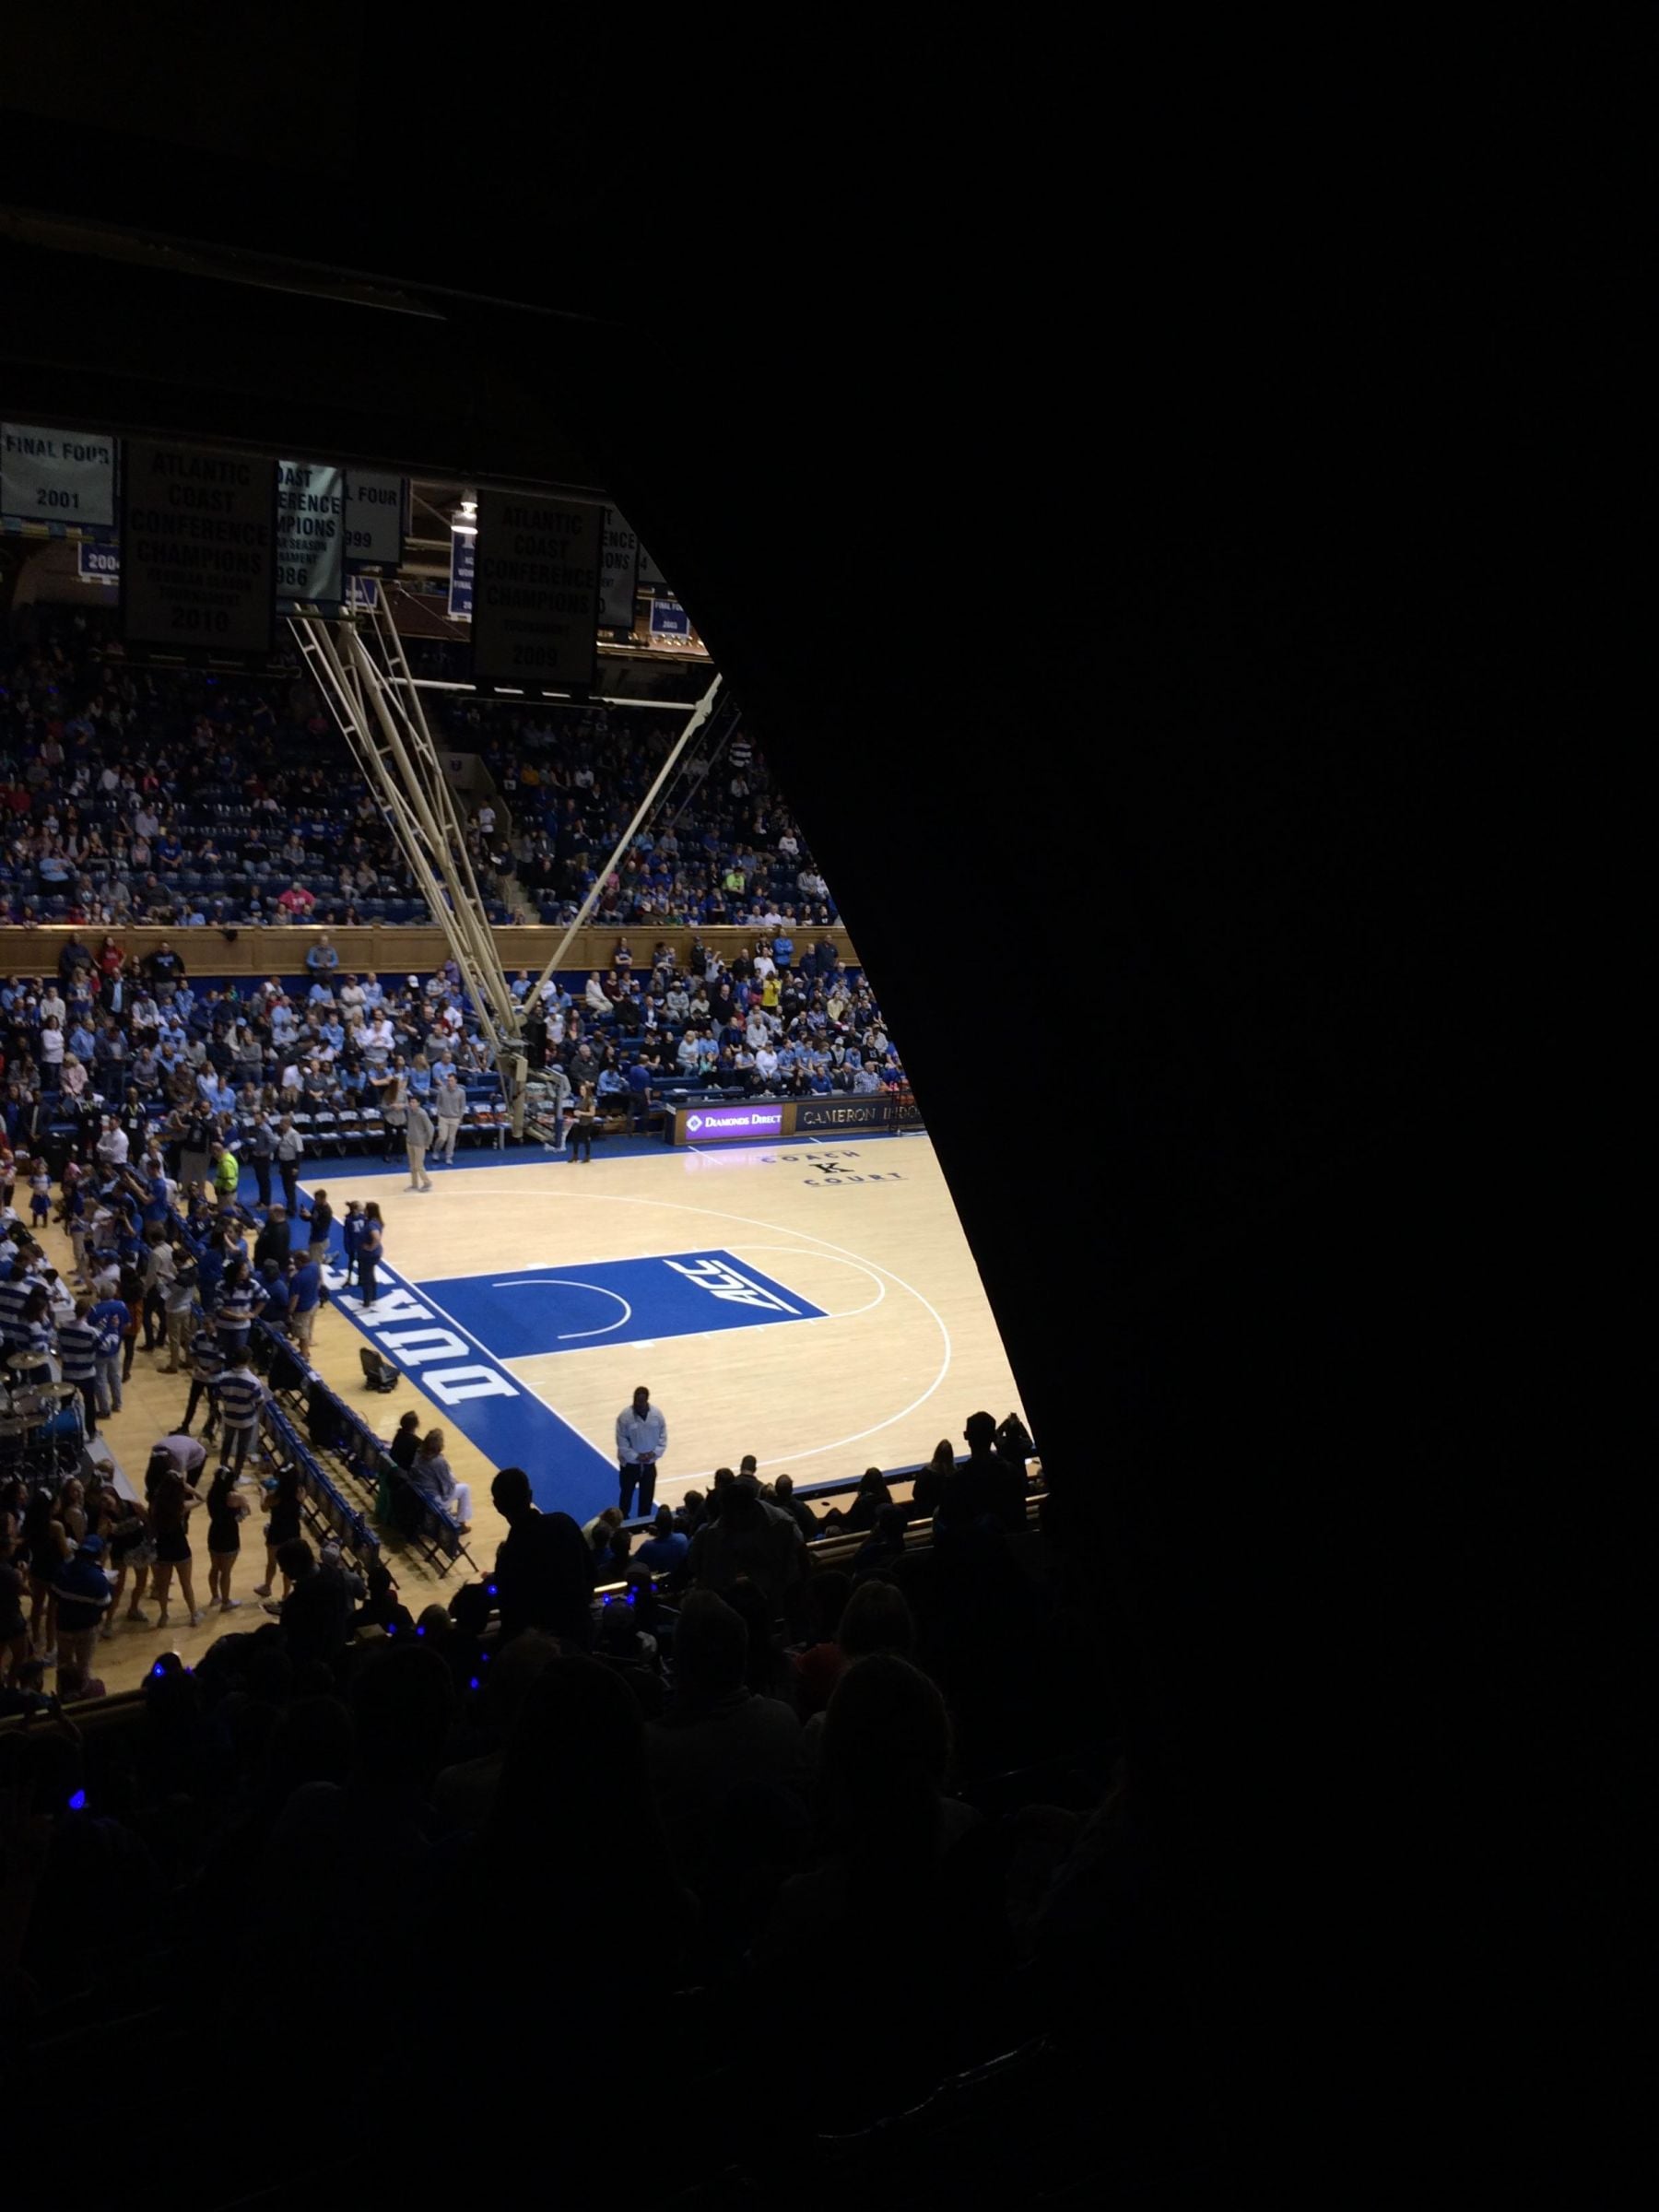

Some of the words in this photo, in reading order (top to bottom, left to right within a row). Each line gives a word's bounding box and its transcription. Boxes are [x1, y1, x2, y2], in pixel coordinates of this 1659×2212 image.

[6, 434, 57, 459] FINAL
[152, 452, 251, 486] ATLANTIC
[37, 488, 80, 509] 2001
[170, 484, 236, 513] COAST
[359, 487, 398, 506] FOUR
[131, 510, 269, 547] CONFERENCE
[501, 506, 582, 535] ATLANTIC
[137, 540, 262, 575] CHAMPIONS
[513, 533, 571, 559] COAST
[483, 557, 594, 589] CONFERENCE
[487, 583, 591, 615] CHAMPIONS
[171, 606, 229, 633] 2010
[514, 645, 559, 667] 2009
[803, 1107, 877, 1125] CAMERON
[760, 1150, 861, 1164] COACH
[808, 1161, 855, 1174] K
[803, 1171, 903, 1186] COURT
[664, 1259, 801, 1315] ACC
[320, 1264, 521, 1406] DUKE
